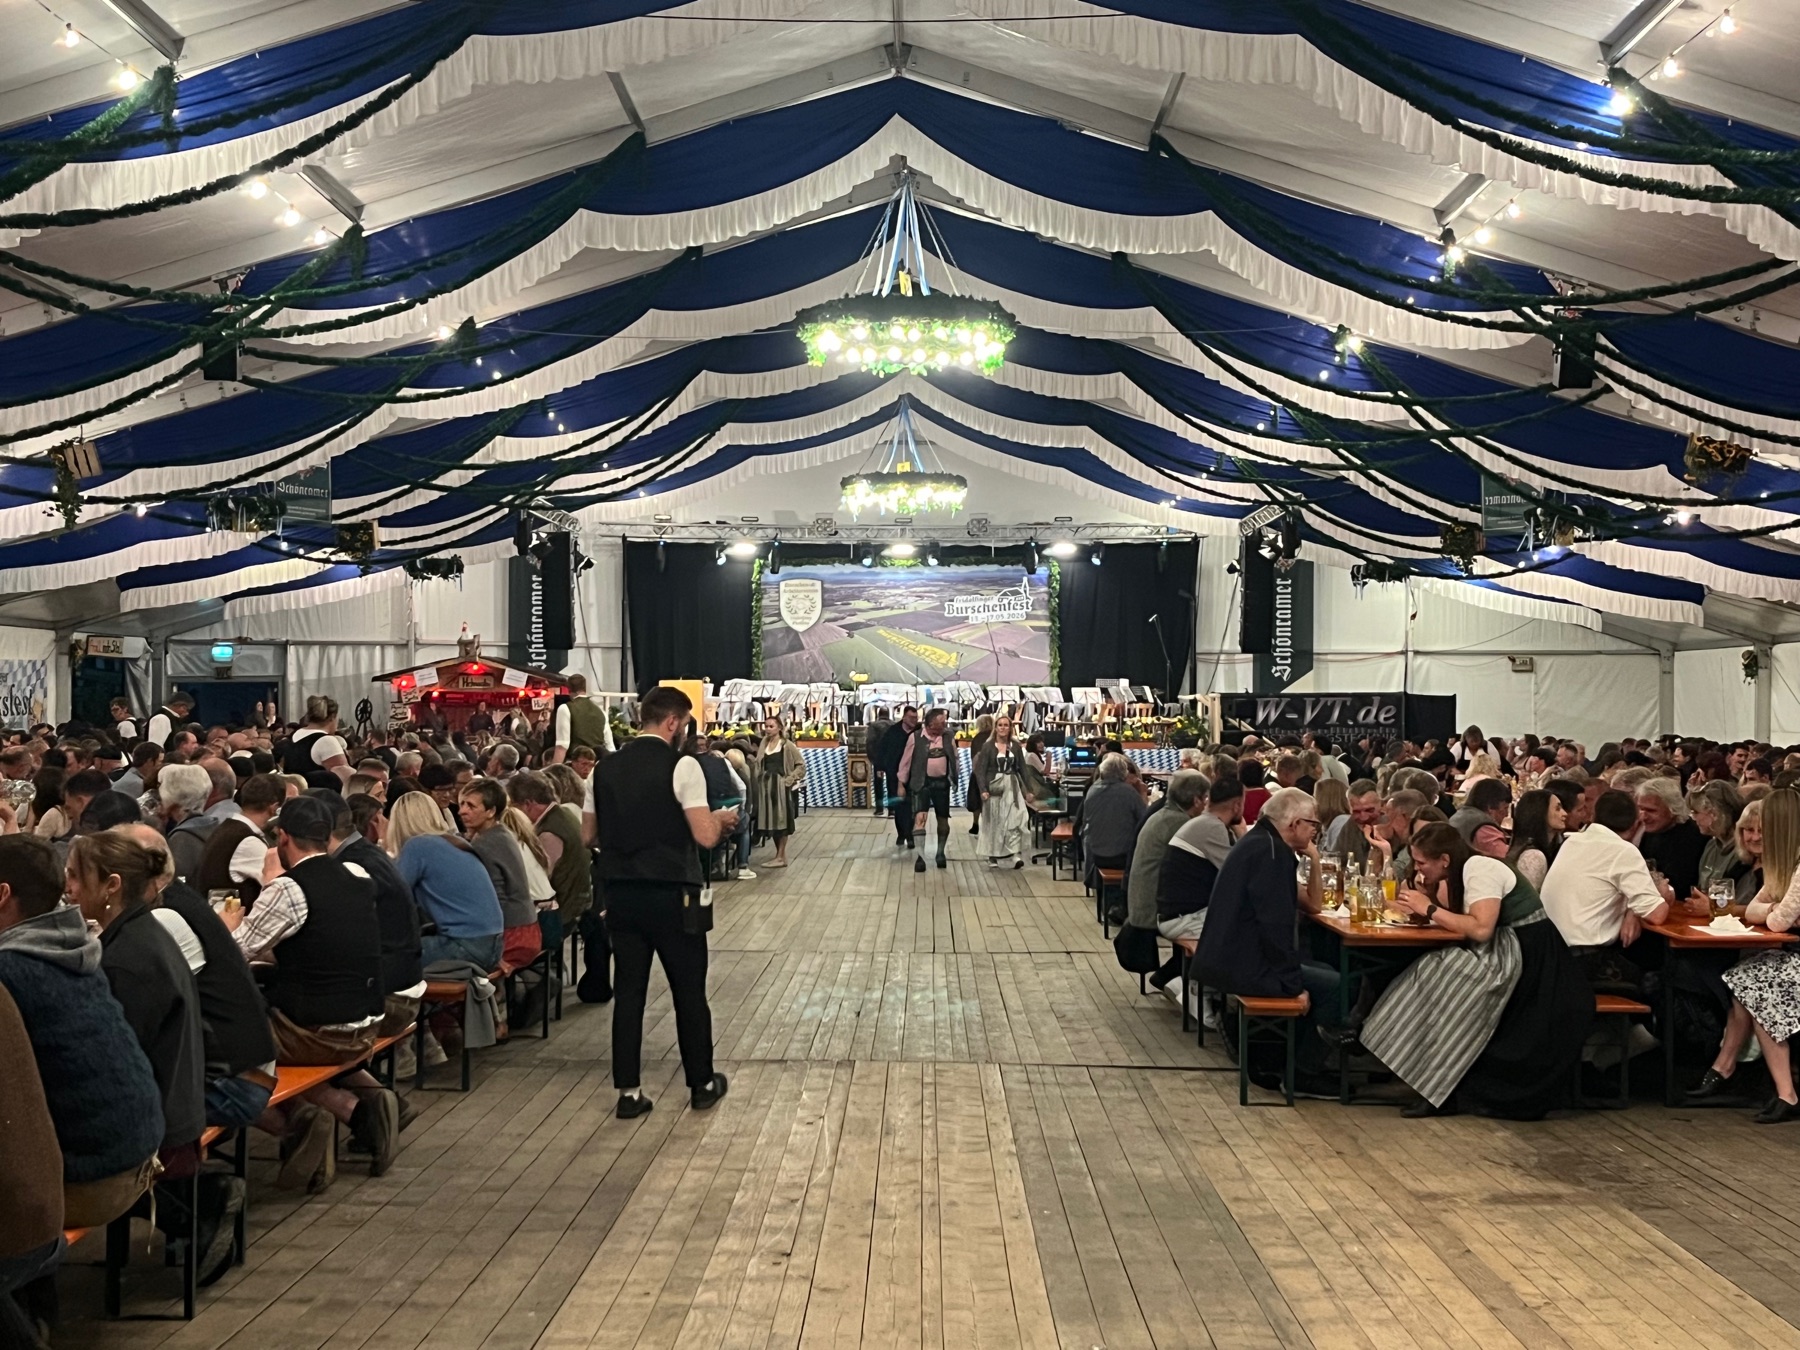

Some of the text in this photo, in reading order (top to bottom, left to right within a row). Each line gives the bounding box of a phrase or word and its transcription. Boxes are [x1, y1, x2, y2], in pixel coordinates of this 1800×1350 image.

[277, 481, 329, 498] Schönramer
[946, 600, 1031, 615] Burschenfest
[1271, 578, 1295, 682] Schönramer
[1255, 695, 1398, 726] W-VT.de
